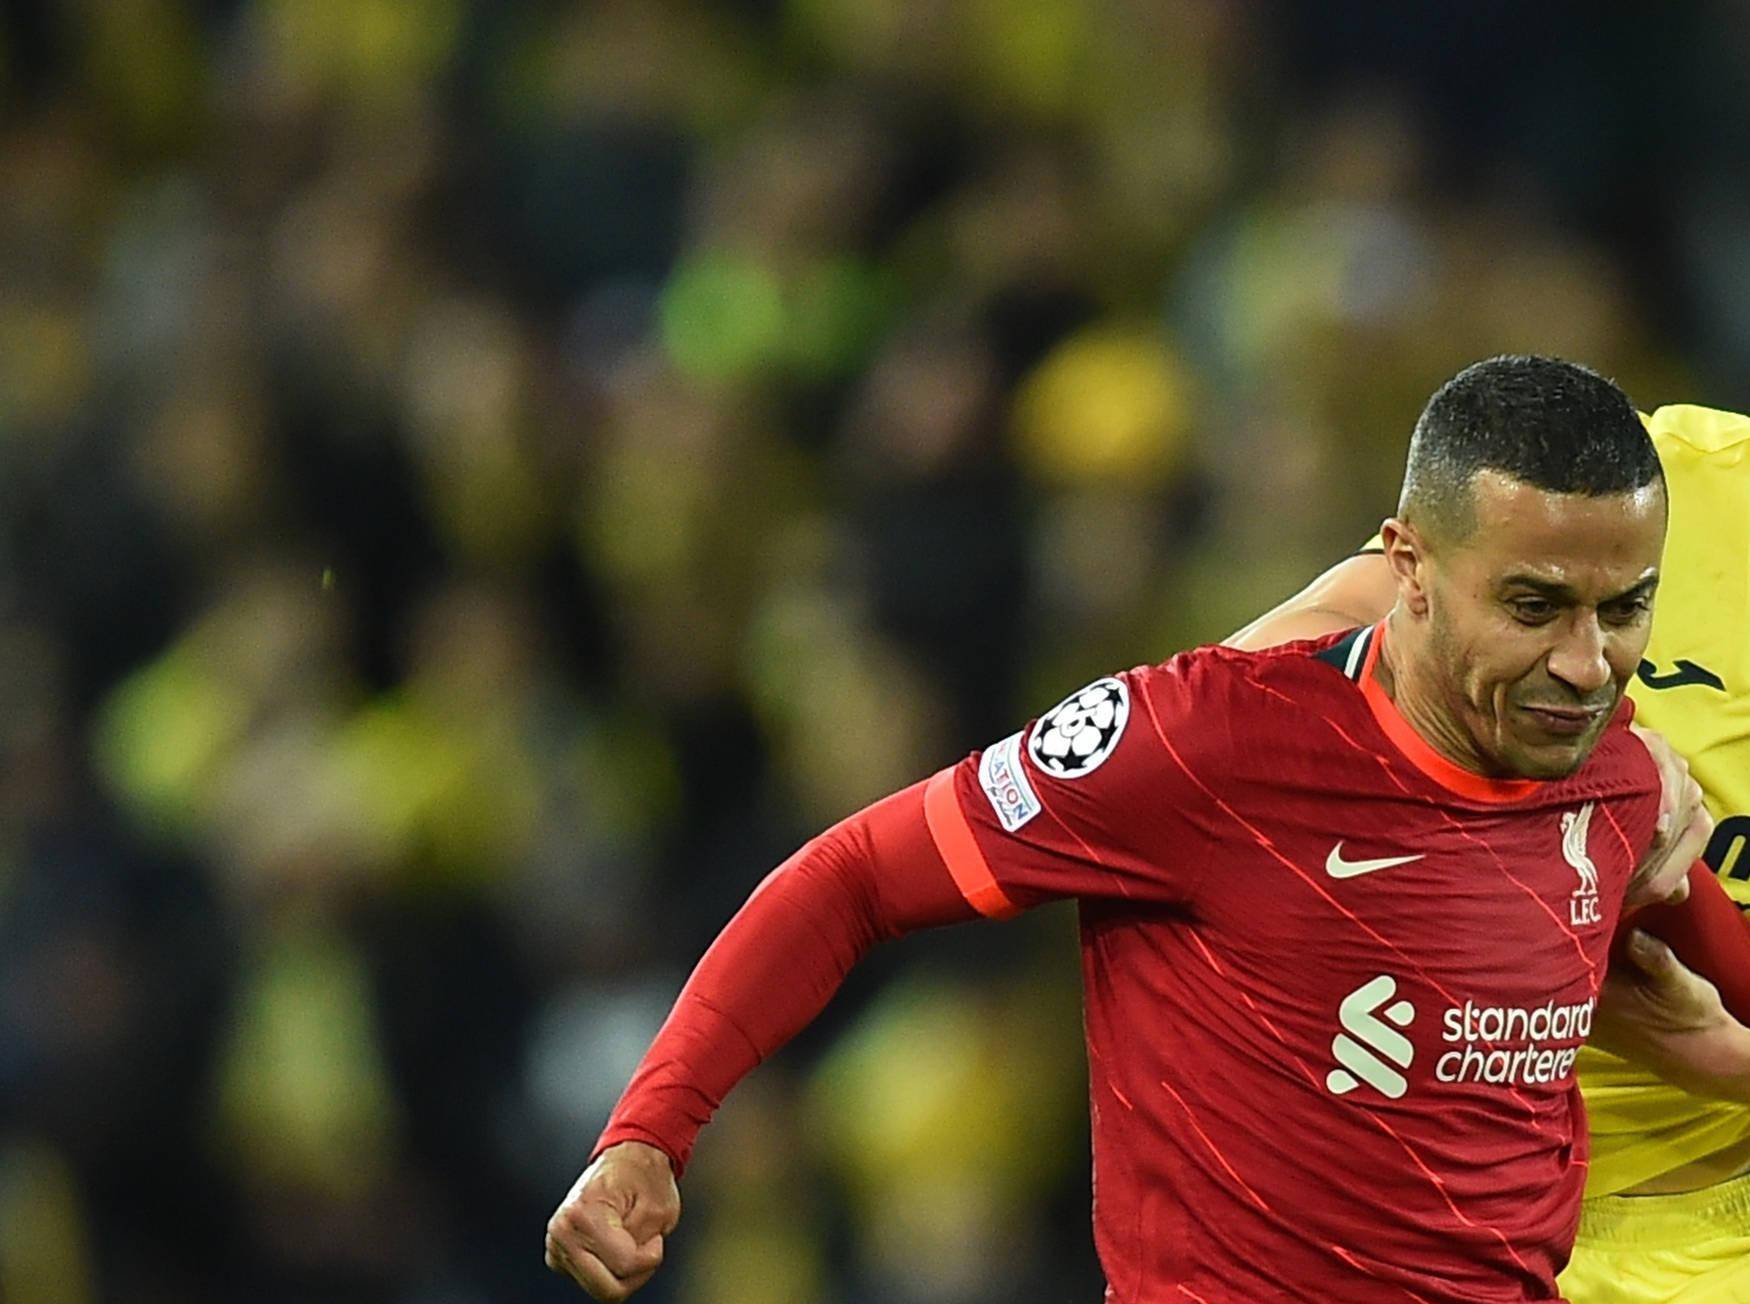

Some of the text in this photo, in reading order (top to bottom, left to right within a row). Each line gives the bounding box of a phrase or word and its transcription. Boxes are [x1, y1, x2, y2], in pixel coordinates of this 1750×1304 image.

[993, 744, 1029, 820] ATION
[1442, 996, 1596, 1041] standard
[1435, 1043, 1577, 1084] chartere
